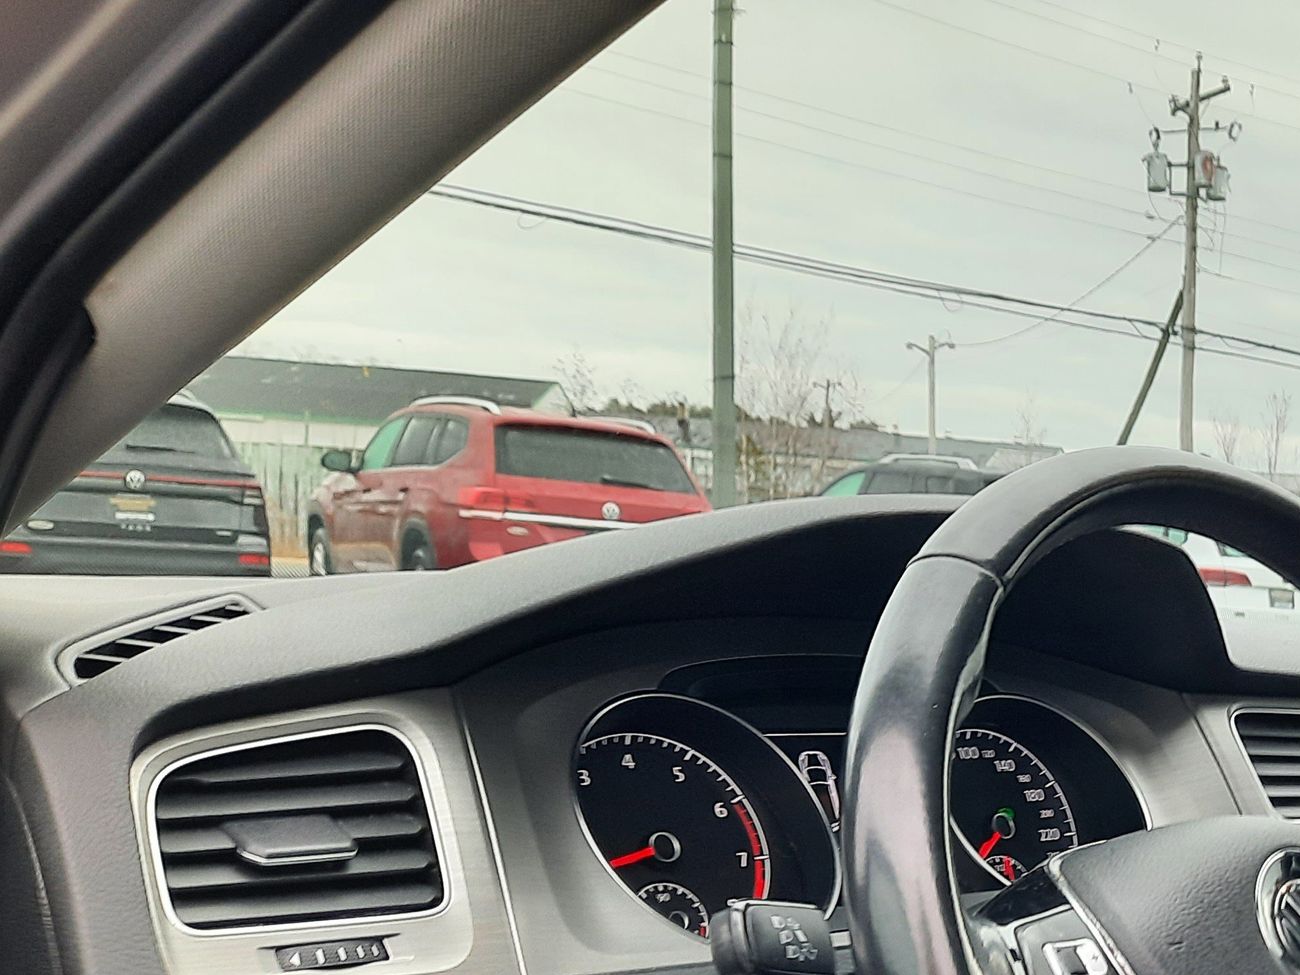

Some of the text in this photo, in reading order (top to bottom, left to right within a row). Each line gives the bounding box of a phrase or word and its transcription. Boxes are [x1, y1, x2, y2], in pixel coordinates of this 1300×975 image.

[621, 753, 636, 769] 4
[993, 760, 1015, 772] 140
[576, 769, 592, 786] 3
[672, 766, 686, 783] 5
[713, 803, 728, 818] 6
[735, 852, 748, 868] 7
